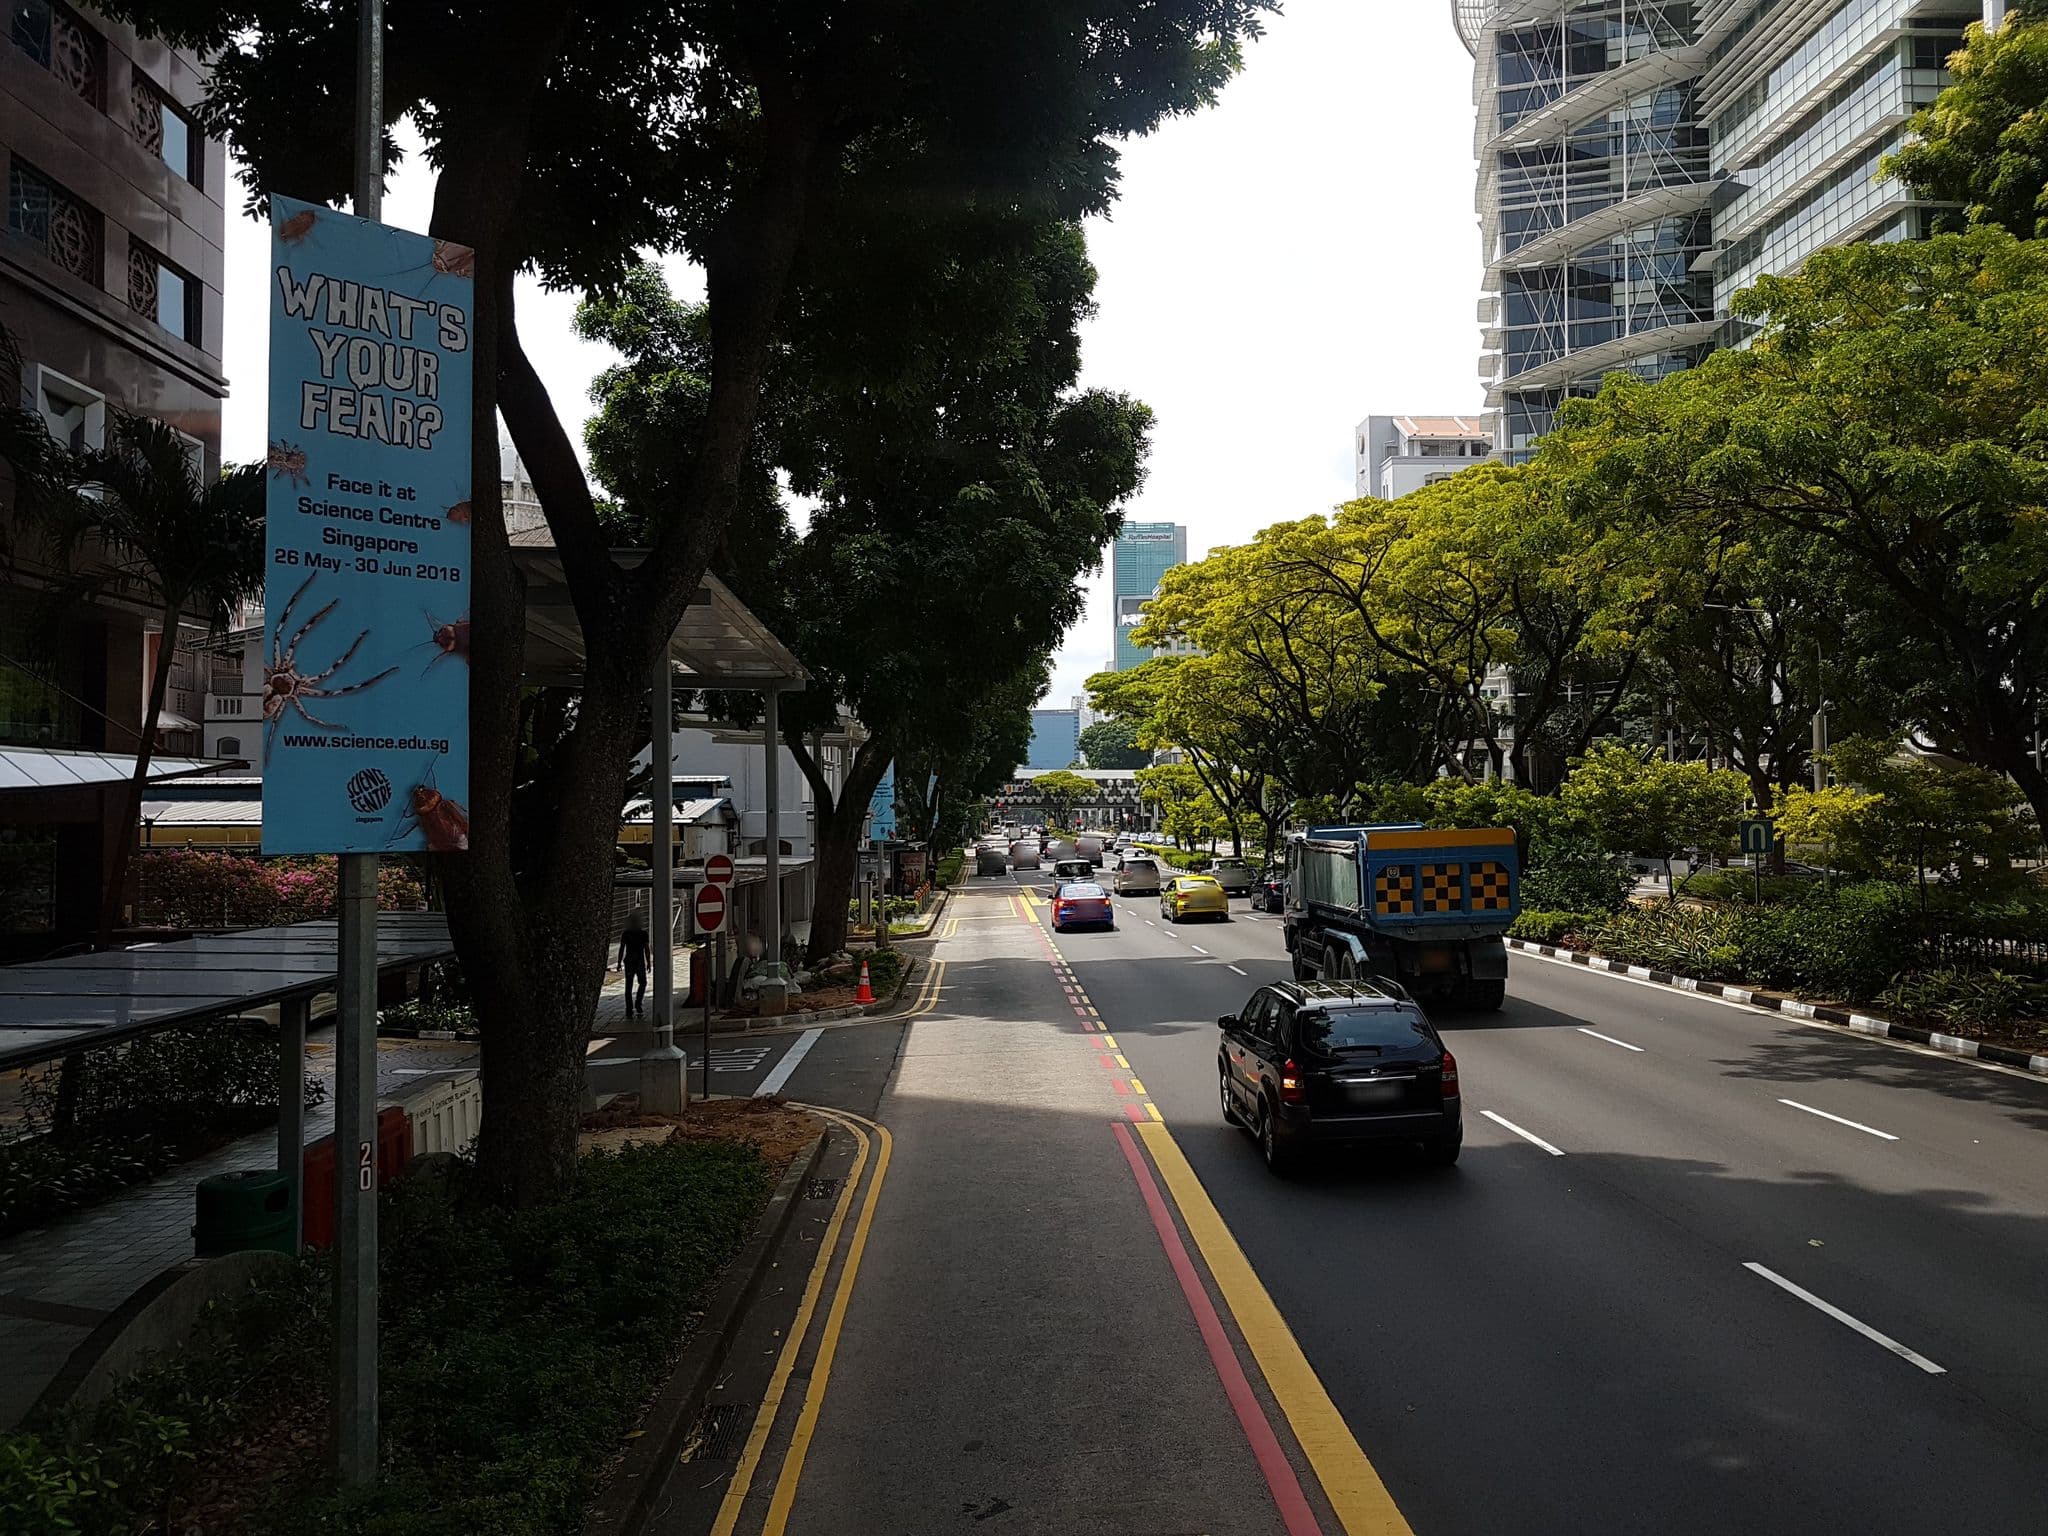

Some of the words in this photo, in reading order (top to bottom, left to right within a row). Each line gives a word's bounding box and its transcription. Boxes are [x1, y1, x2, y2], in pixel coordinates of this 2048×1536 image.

[276, 265, 468, 352] WHAT'S
[308, 327, 439, 400] YOUR
[300, 380, 443, 450] FEAR?
[327, 473, 373, 495] Face
[378, 480, 392, 498] it
[396, 486, 416, 501] at
[298, 496, 374, 522] Science
[379, 507, 441, 531] Centre
[322, 527, 418, 554] Singapore
[274, 548, 299, 565] 26
[304, 551, 341, 573] May
[355, 557, 379, 574] 30
[383, 560, 412, 577] Jun
[416, 564, 460, 582] 2018
[284, 734, 449, 753] www.science.edu.sg
[347, 768, 389, 798] SCIENCE
[351, 782, 392, 813] CENTRE
[361, 1142, 371, 1190] 20
